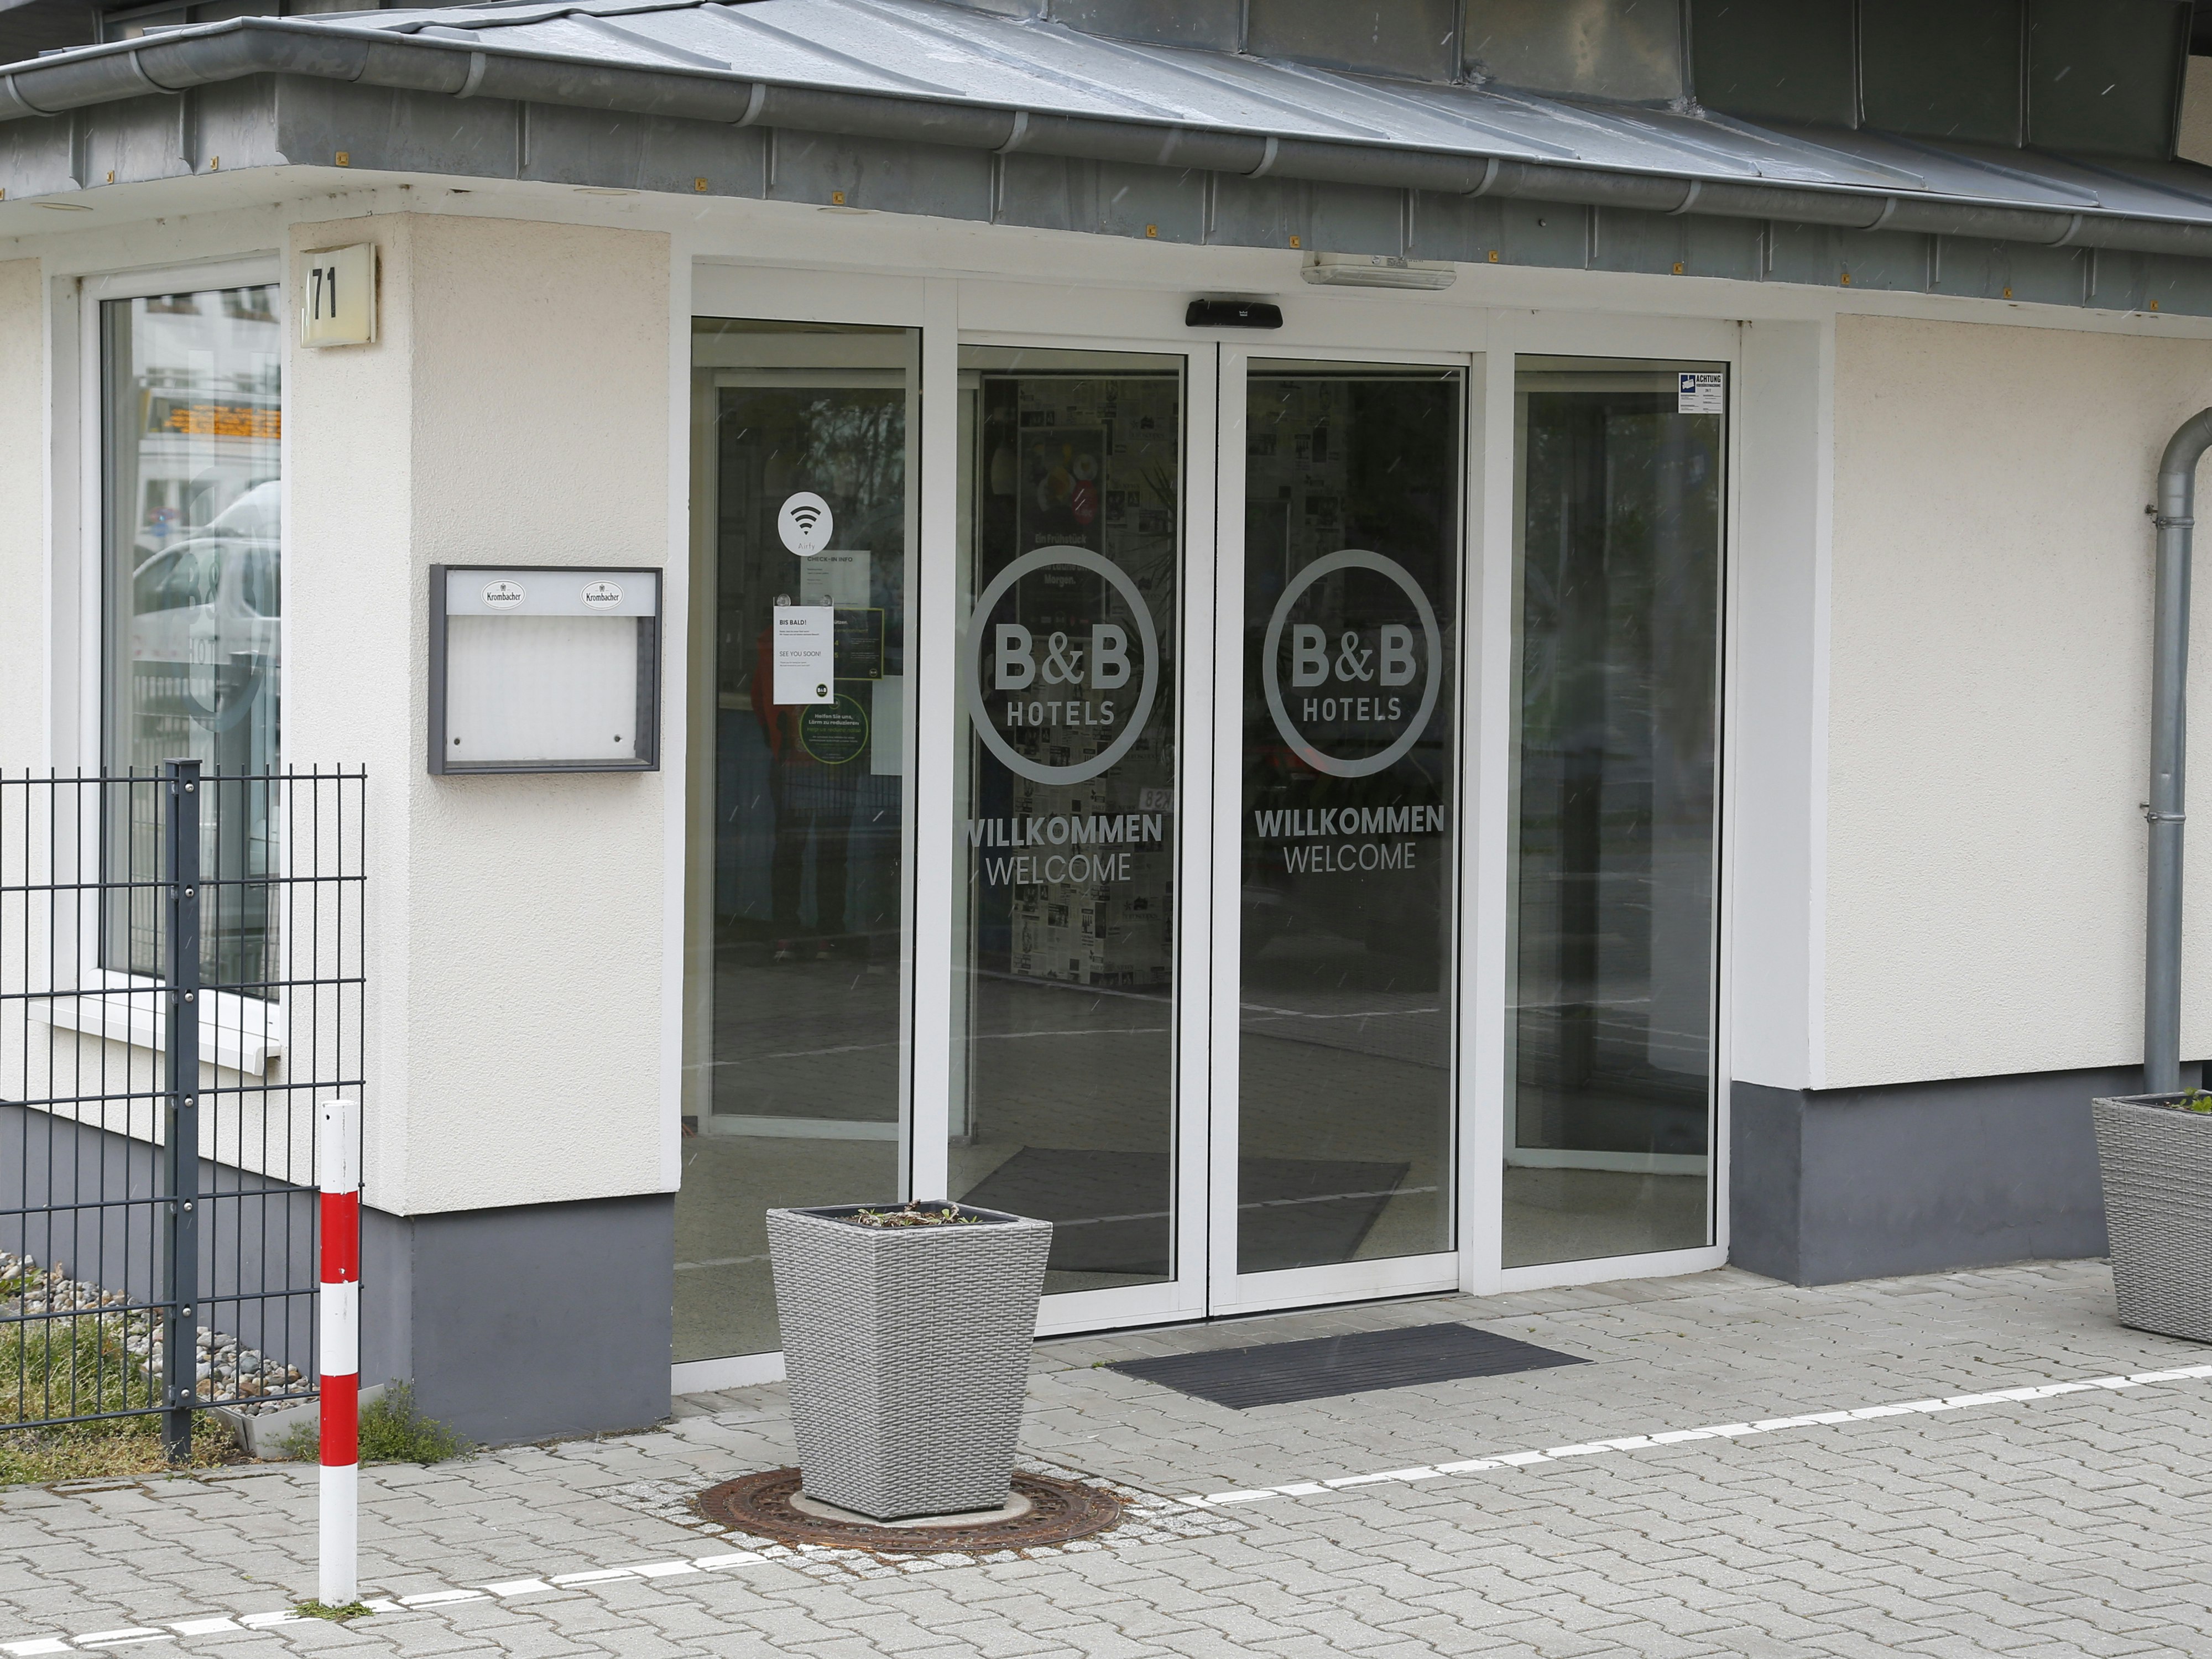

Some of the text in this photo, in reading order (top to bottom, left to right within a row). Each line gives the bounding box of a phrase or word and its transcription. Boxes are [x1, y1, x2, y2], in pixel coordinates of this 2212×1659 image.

[312, 267, 336, 320] 71
[797, 542, 816, 551] Airfy
[1035, 533, 1087, 544] Ein Frühstück
[1044, 574, 1077, 587] Morgen.
[487, 592, 521, 601] Krombacher
[586, 592, 619, 602] Krombacher
[995, 623, 1131, 690] B&B
[1292, 623, 1417, 687] B&B
[1008, 701, 1115, 726] HOTELS
[1303, 697, 1401, 722] HOTELS
[965, 814, 1162, 847] WILLKOMMEN
[1255, 805, 1444, 837] WILLKOMMEN
[986, 853, 1131, 885] WELCOME
[1284, 842, 1416, 873] WELCOME
